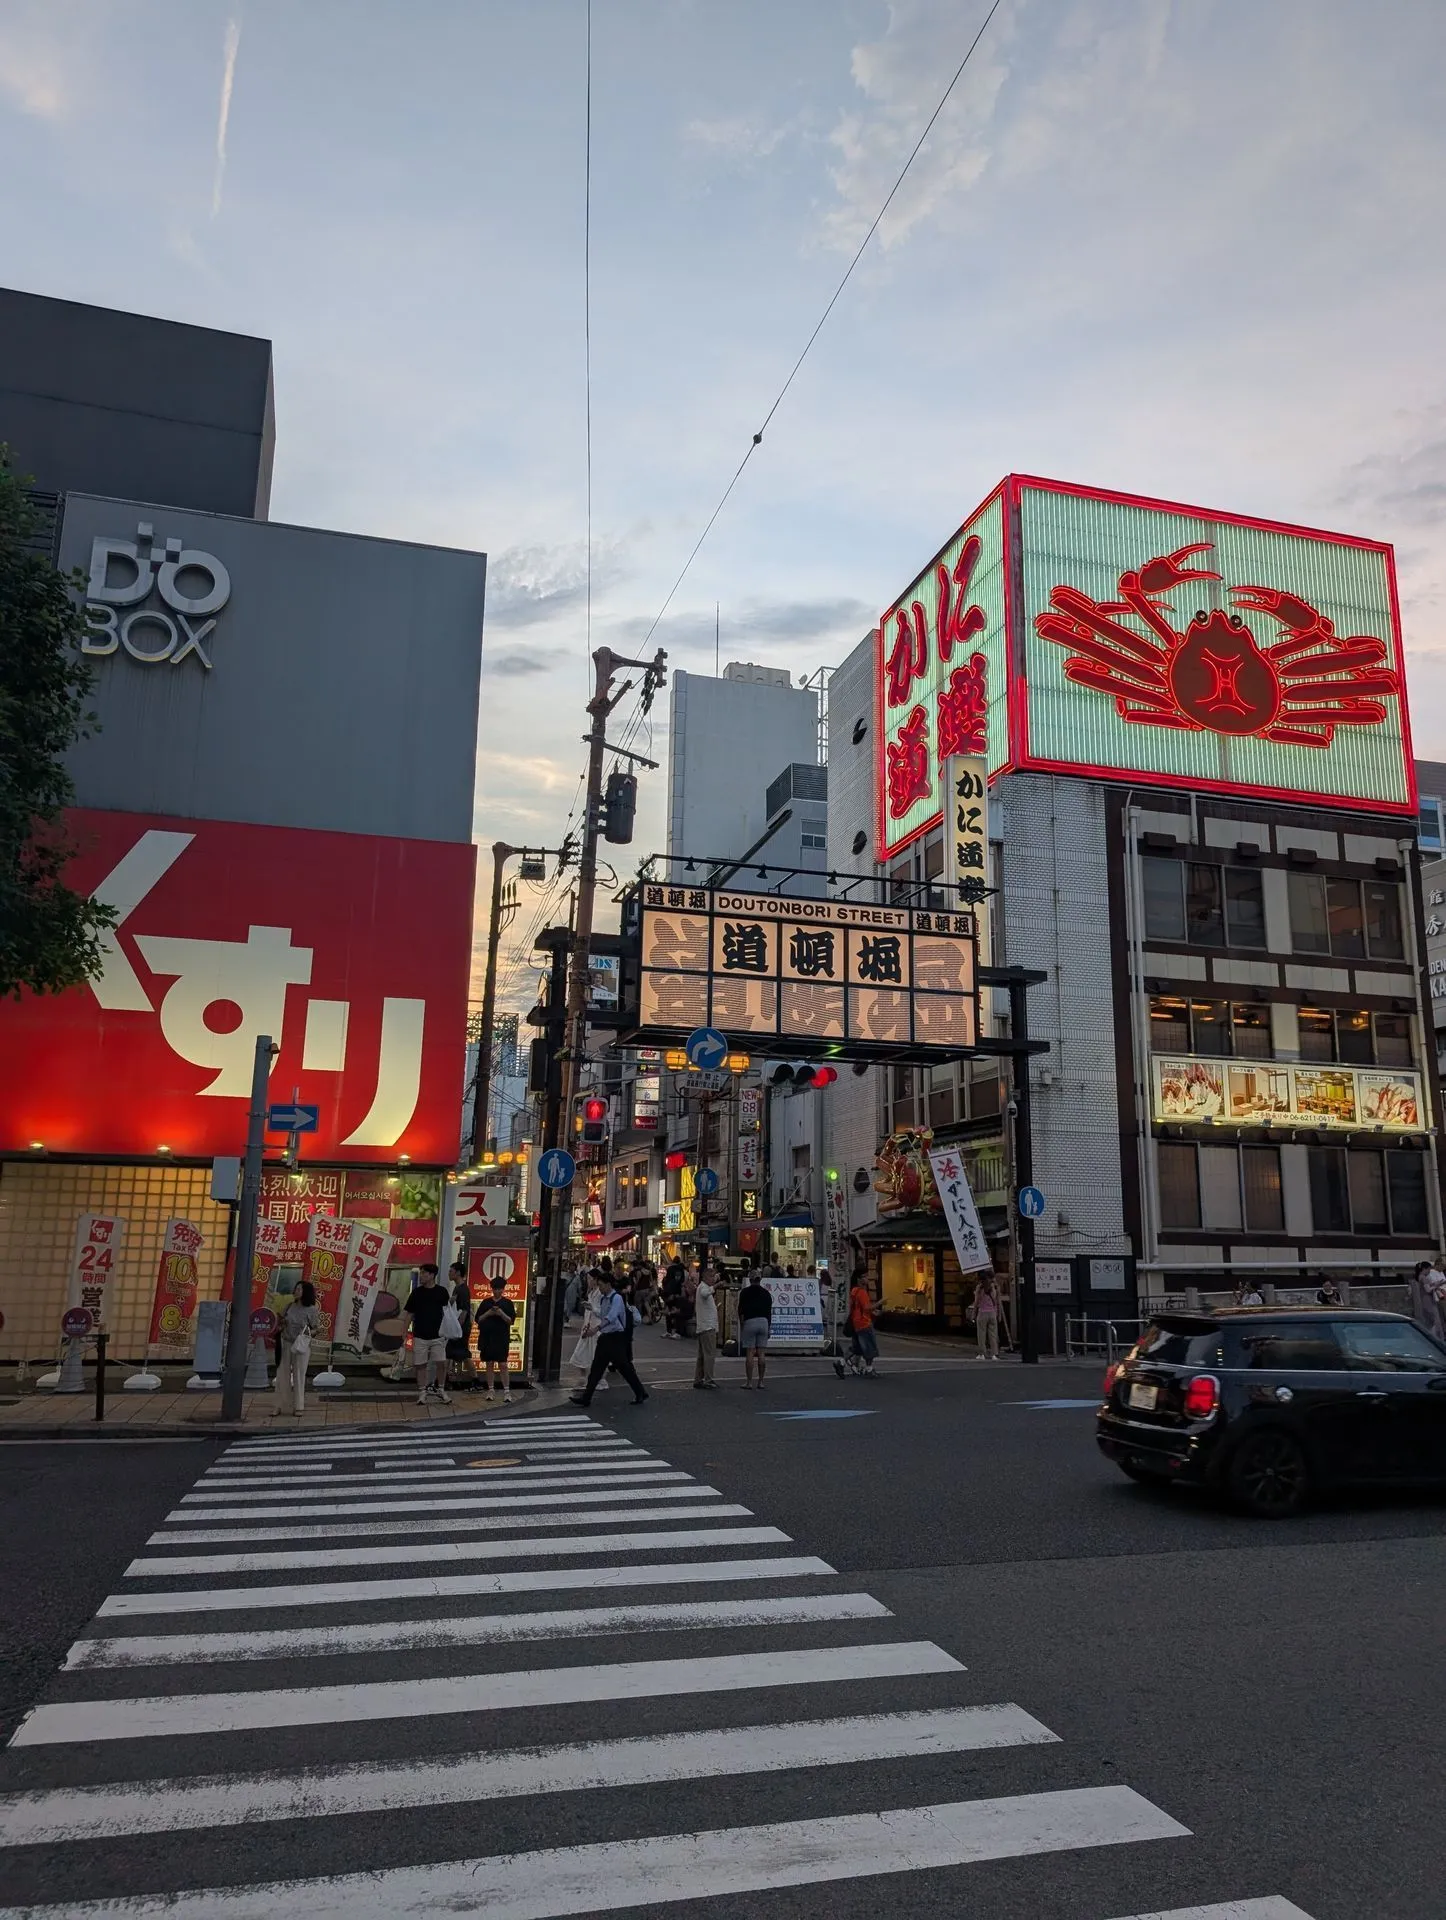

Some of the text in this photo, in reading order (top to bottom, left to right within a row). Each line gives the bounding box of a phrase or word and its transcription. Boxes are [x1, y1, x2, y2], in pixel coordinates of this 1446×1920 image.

[885, 533, 988, 708] かに
[81, 602, 217, 668] BOX
[647, 887, 706, 909] 道頓堀
[718, 896, 905, 925] DOUTONBORI STREET
[916, 912, 969, 934] 道頓堀
[722, 922, 902, 983] 道頓堀
[86, 829, 426, 1147] くすり
[315, 1219, 351, 1242] 免税
[79, 1246, 114, 1272] 24
[256, 1243, 274, 1253] Free
[315, 1239, 346, 1251] Tax Free
[310, 1250, 344, 1281] 10%
[351, 1256, 379, 1286] 24
[160, 1306, 191, 1333] 8%
